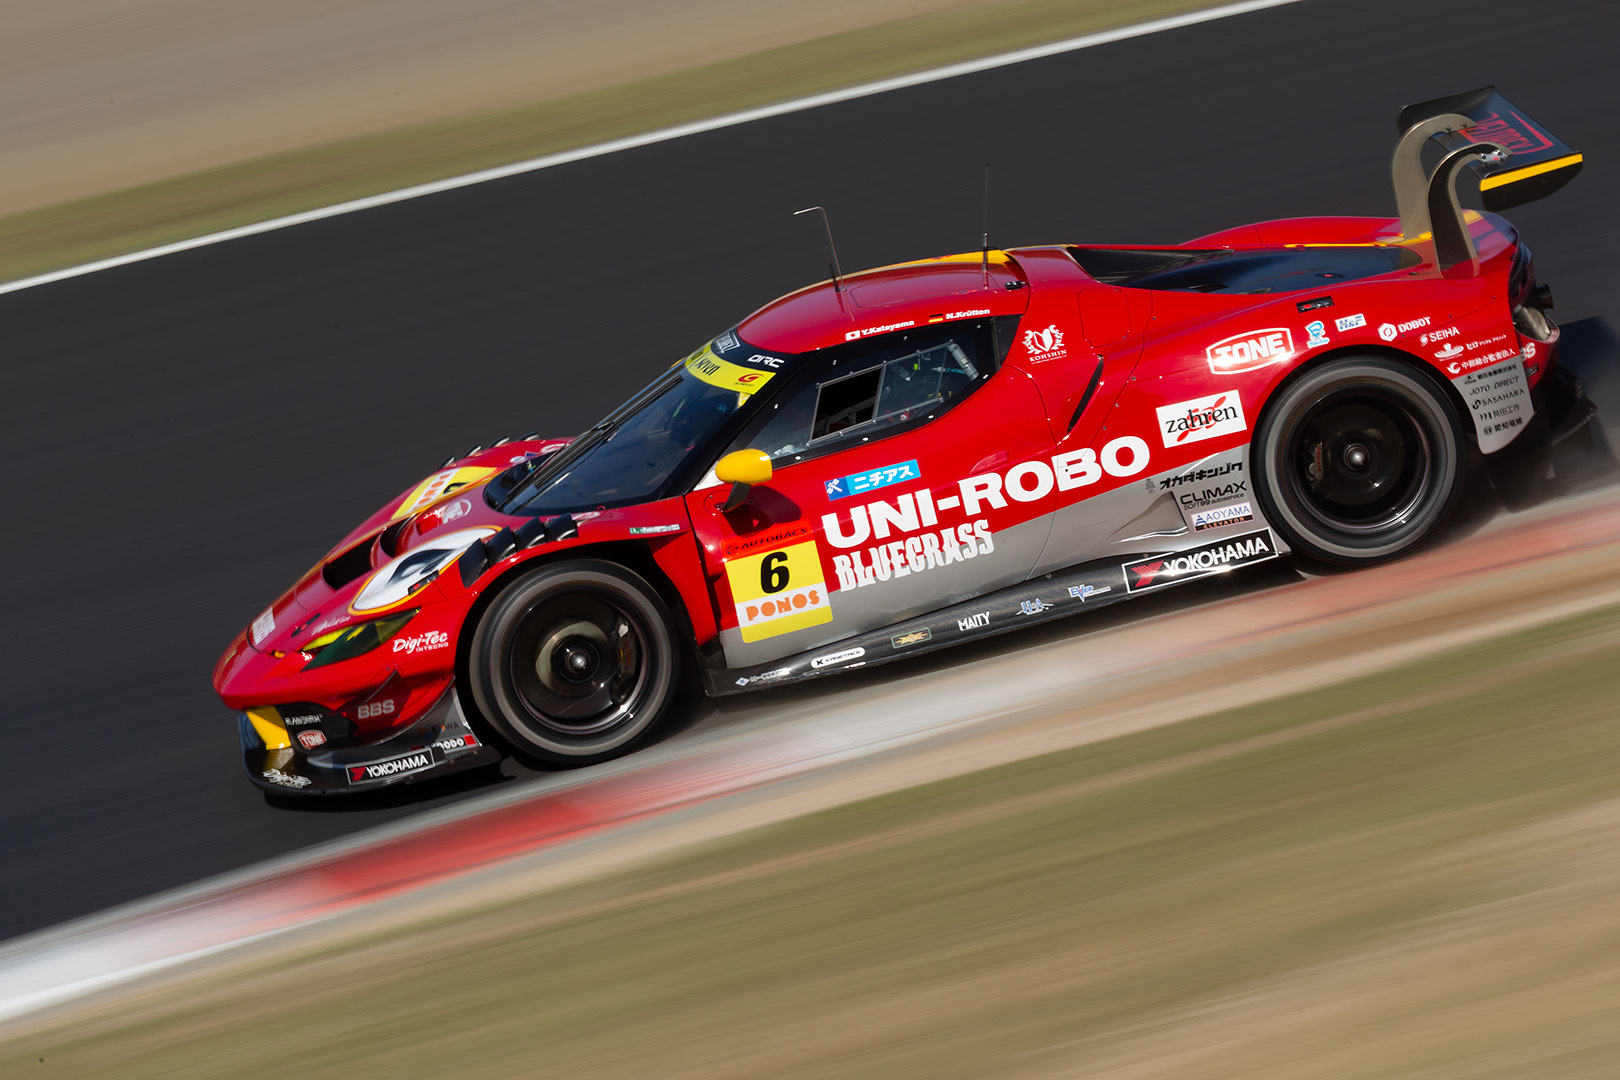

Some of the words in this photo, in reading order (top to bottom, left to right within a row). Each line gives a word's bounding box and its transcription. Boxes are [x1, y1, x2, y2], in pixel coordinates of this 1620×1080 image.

[861, 320, 915, 336] Y.Katayama
[1397, 316, 1431, 333] DOBOT
[1429, 326, 1460, 343] SEIHA
[1029, 348, 1068, 362] KOHSHIN
[1216, 332, 1285, 367] TONE
[1470, 384, 1491, 396] JOTO
[1494, 376, 1520, 389] DIRECT
[1482, 388, 1525, 406] SASAHARA
[1165, 405, 1239, 434] zahren
[854, 465, 914, 490] ニチアス
[1160, 462, 1243, 490] オカダキンゾク
[821, 436, 1150, 548] UNI-ROBO
[1180, 481, 1247, 505] CLIMAX
[1204, 516, 1245, 529] ELEVATOR
[1206, 505, 1250, 521] AOYAMA
[741, 528, 807, 549] AUTOBACS
[832, 519, 995, 592] BLUEGRASS
[1163, 537, 1269, 576] YOKOHAMA
[760, 551, 790, 594] 6
[745, 589, 820, 621] PONOS
[393, 630, 448, 655] Digi-Tec
[357, 699, 395, 720] BBS
[366, 754, 429, 779] YOKOHAMA
